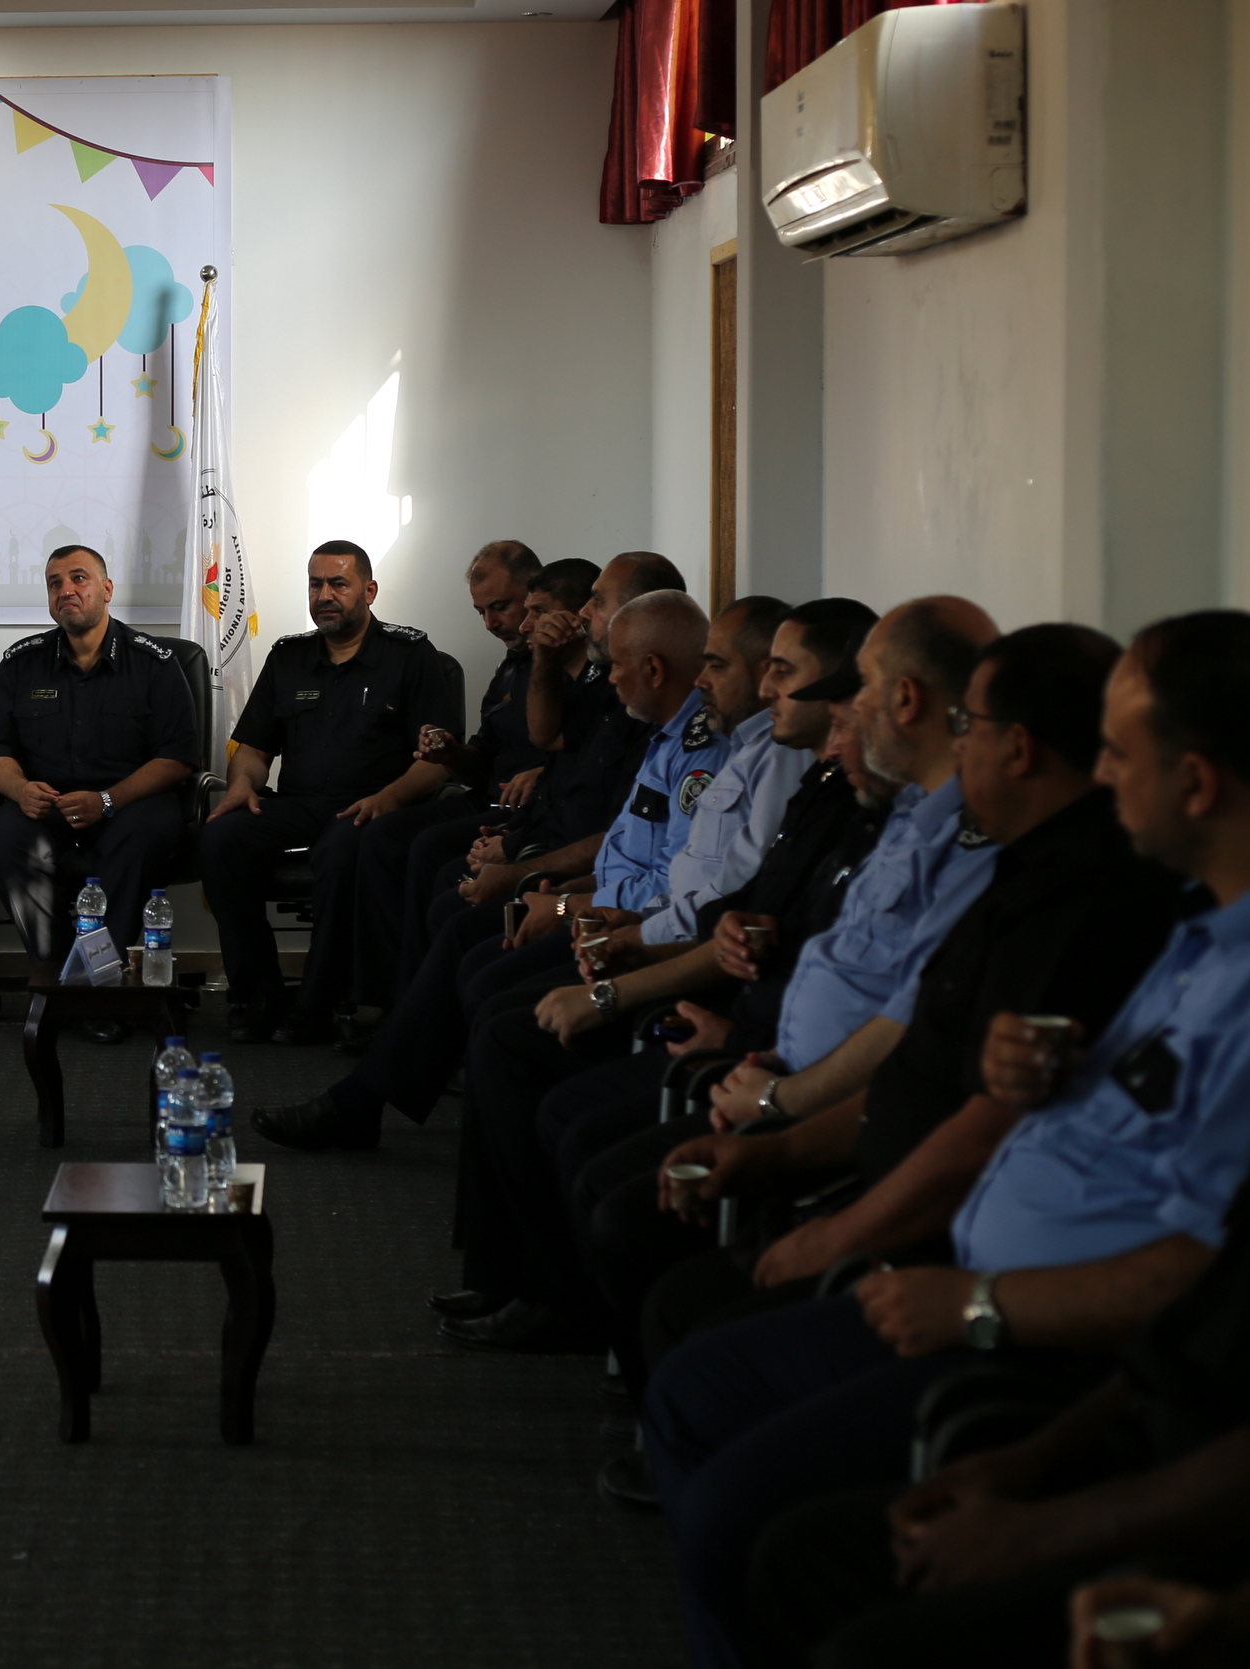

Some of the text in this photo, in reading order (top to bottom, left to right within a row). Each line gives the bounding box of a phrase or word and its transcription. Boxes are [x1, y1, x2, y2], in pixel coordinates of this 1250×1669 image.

[219, 567, 232, 619] nterior
[220, 535, 246, 651] ATIONAL AUTHORITY
